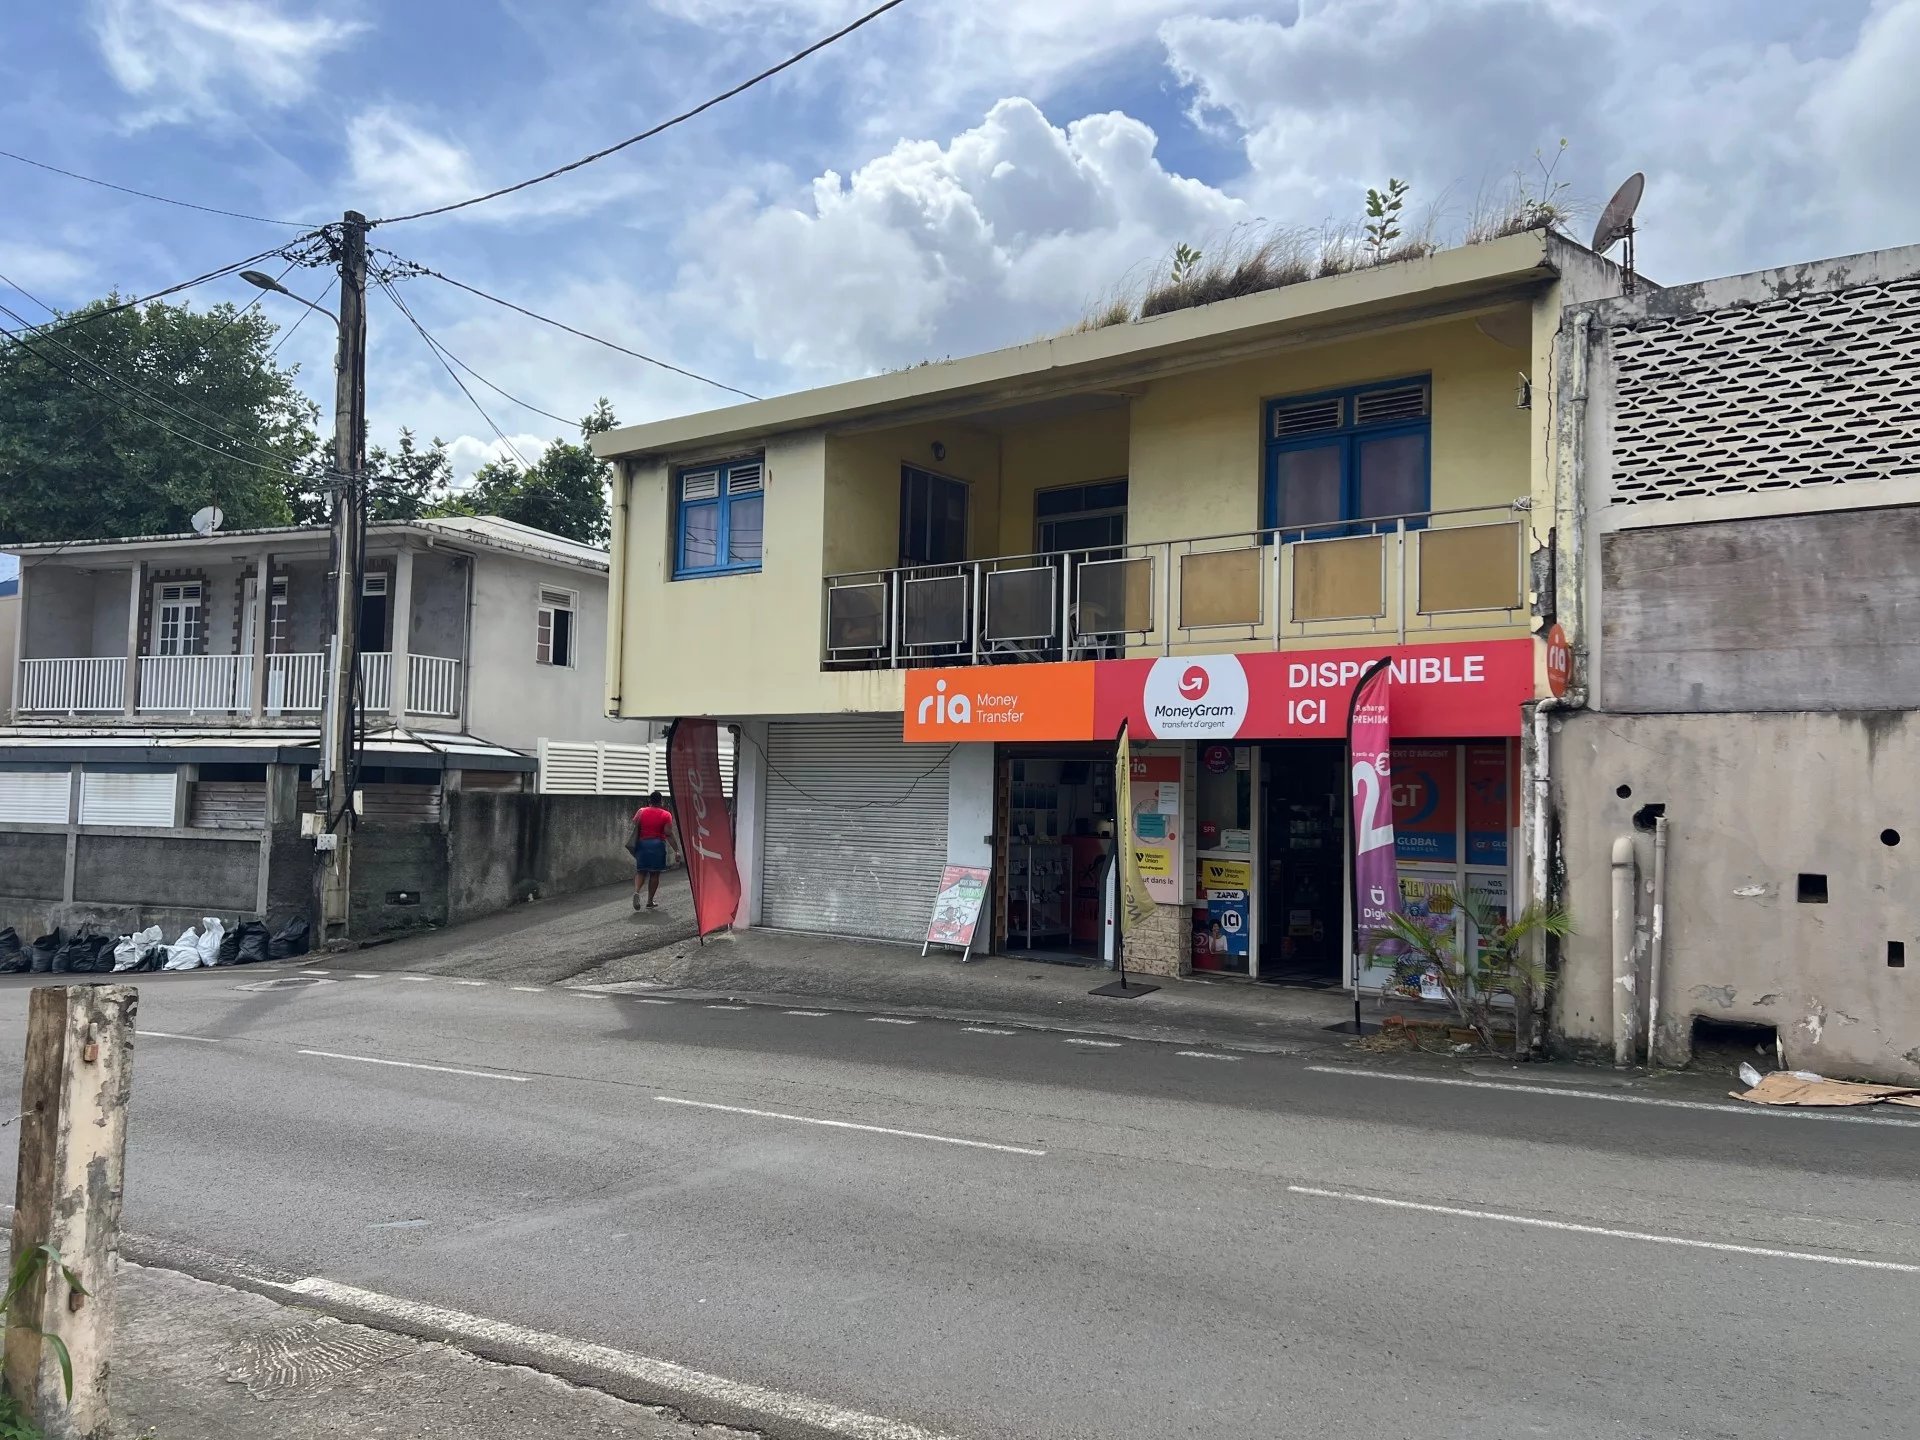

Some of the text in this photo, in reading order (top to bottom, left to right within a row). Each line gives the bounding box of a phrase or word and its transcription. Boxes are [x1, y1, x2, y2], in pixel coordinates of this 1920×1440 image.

[1549, 633, 1566, 673] ria
[918, 679, 971, 724] ria
[977, 693, 1018, 708] Money
[976, 709, 1024, 723] Transfer
[1154, 704, 1234, 720] MoneyGram
[1288, 699, 1327, 725] ICI
[1353, 714, 1389, 724] PREMIUM
[1162, 720, 1226, 729] transfert d'argent
[1391, 784, 1422, 807] GT
[687, 767, 723, 861] free
[1397, 837, 1439, 847] GLOBAL
[1404, 880, 1426, 898] NEW
[1224, 913, 1239, 927] ICI
